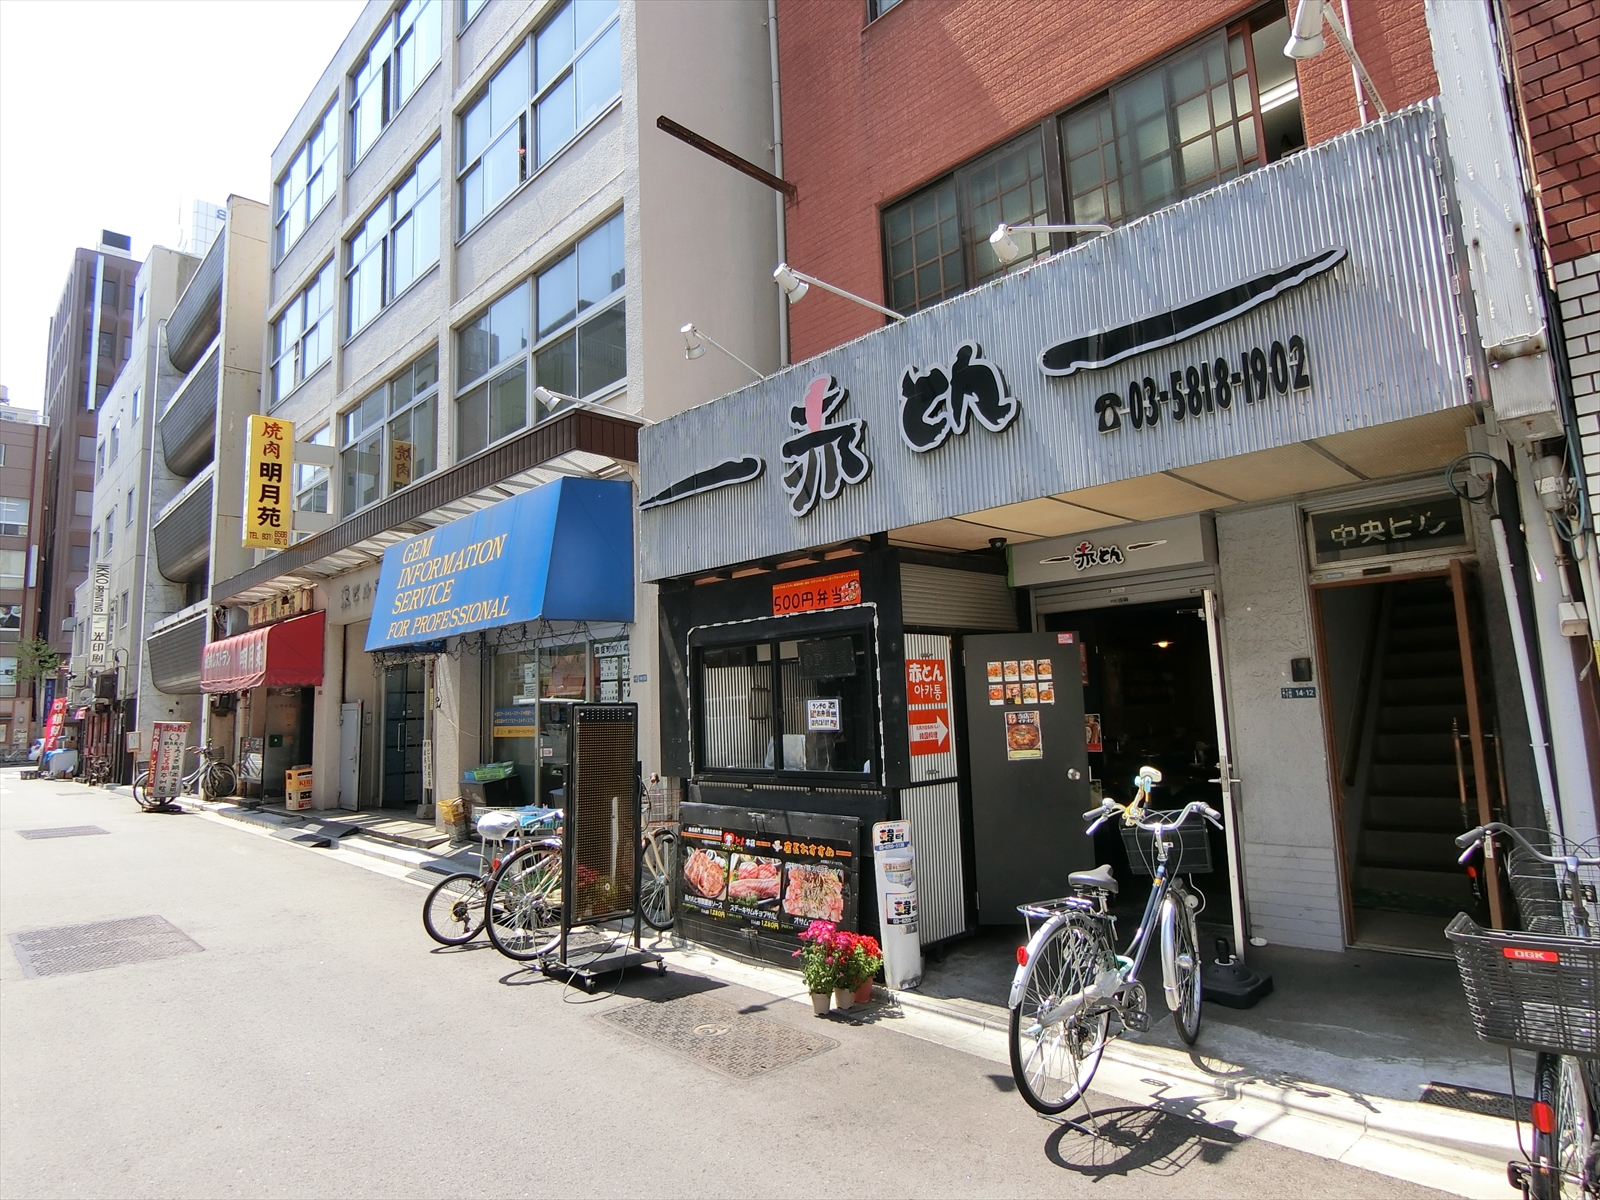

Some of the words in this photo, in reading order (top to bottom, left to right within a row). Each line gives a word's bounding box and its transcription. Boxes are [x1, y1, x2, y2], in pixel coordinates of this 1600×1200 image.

[1129, 335, 1311, 432] 03-5818-1902
[396, 533, 508, 590] INFORMATION
[402, 535, 435, 565] GEM
[95, 564, 110, 585] IKKO
[391, 579, 455, 615] SERVICE
[386, 619, 411, 640] FOR
[410, 595, 510, 636] PROFESSIONAL
[908, 662, 943, 683] 赤とん
[914, 684, 942, 700] 아카통
